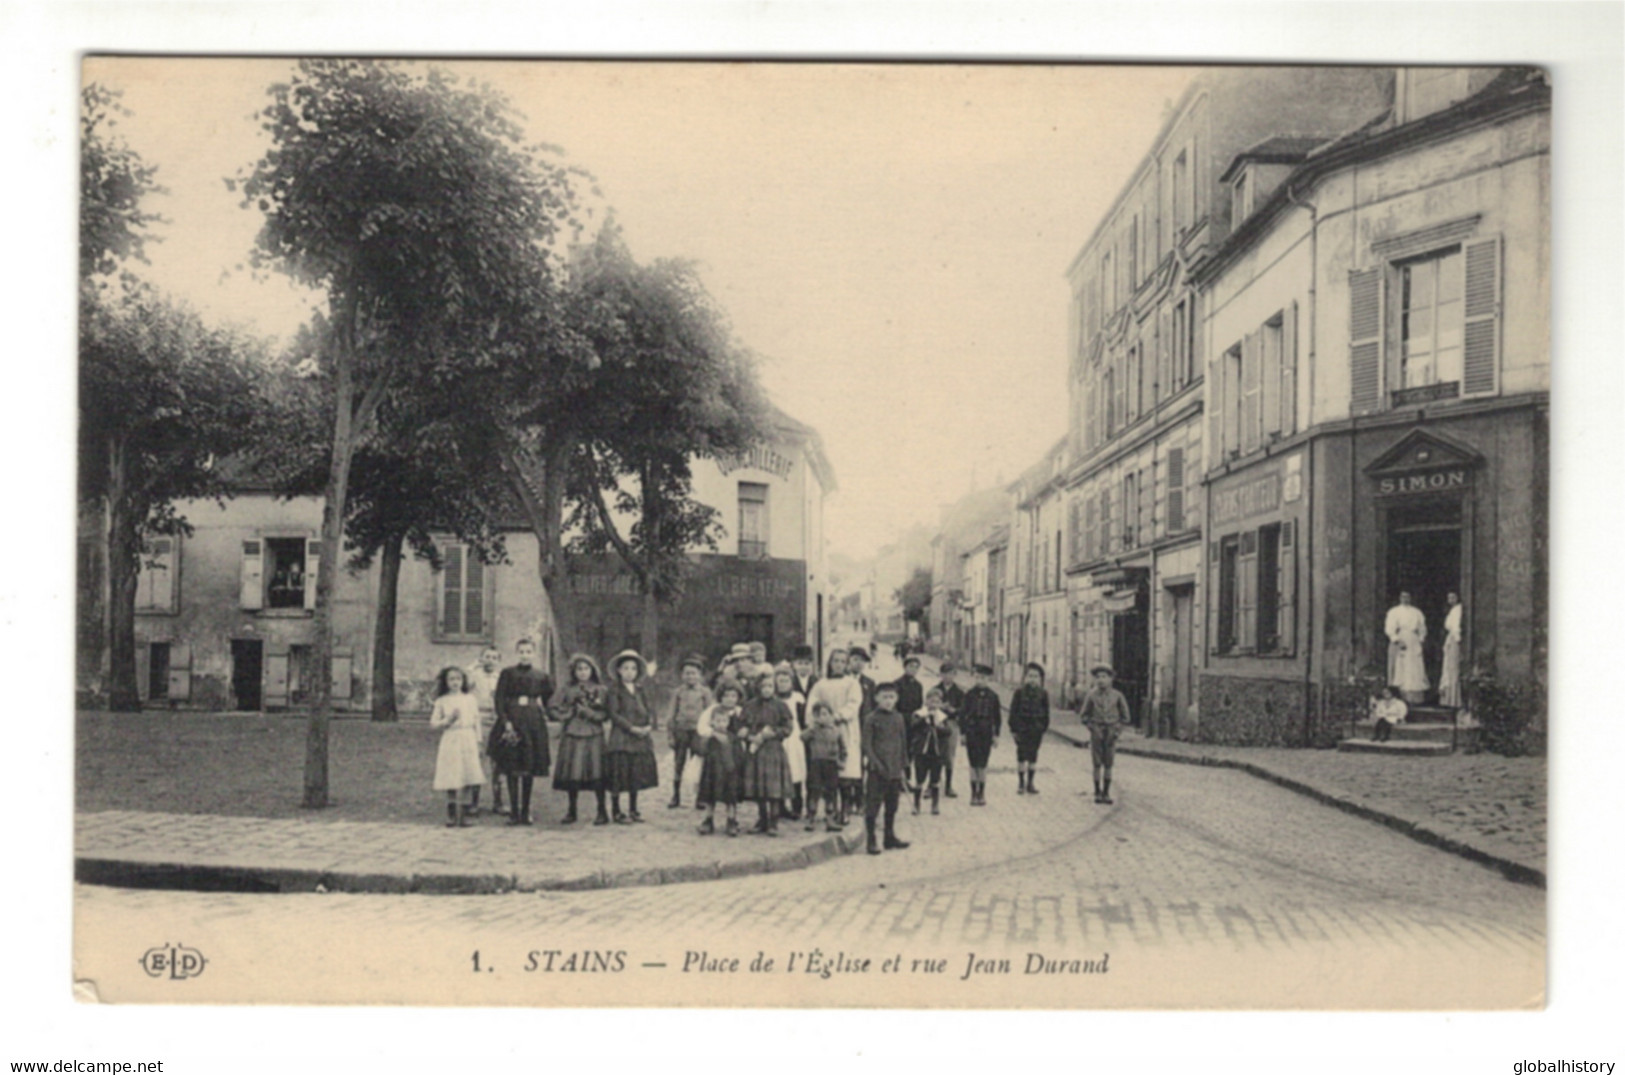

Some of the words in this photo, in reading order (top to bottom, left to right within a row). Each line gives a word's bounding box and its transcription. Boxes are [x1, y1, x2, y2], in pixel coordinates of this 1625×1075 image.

[1381, 471, 1464, 494] SIMON
[471, 950, 495, 973] 1.
[524, 950, 628, 973] STAINS
[682, 950, 740, 973] Place
[749, 951, 774, 973] de
[787, 948, 871, 980] l'Église
[881, 954, 902, 973] et
[911, 959, 947, 973] rue
[960, 952, 1010, 980] Jean
[1024, 952, 1110, 975] Durand
